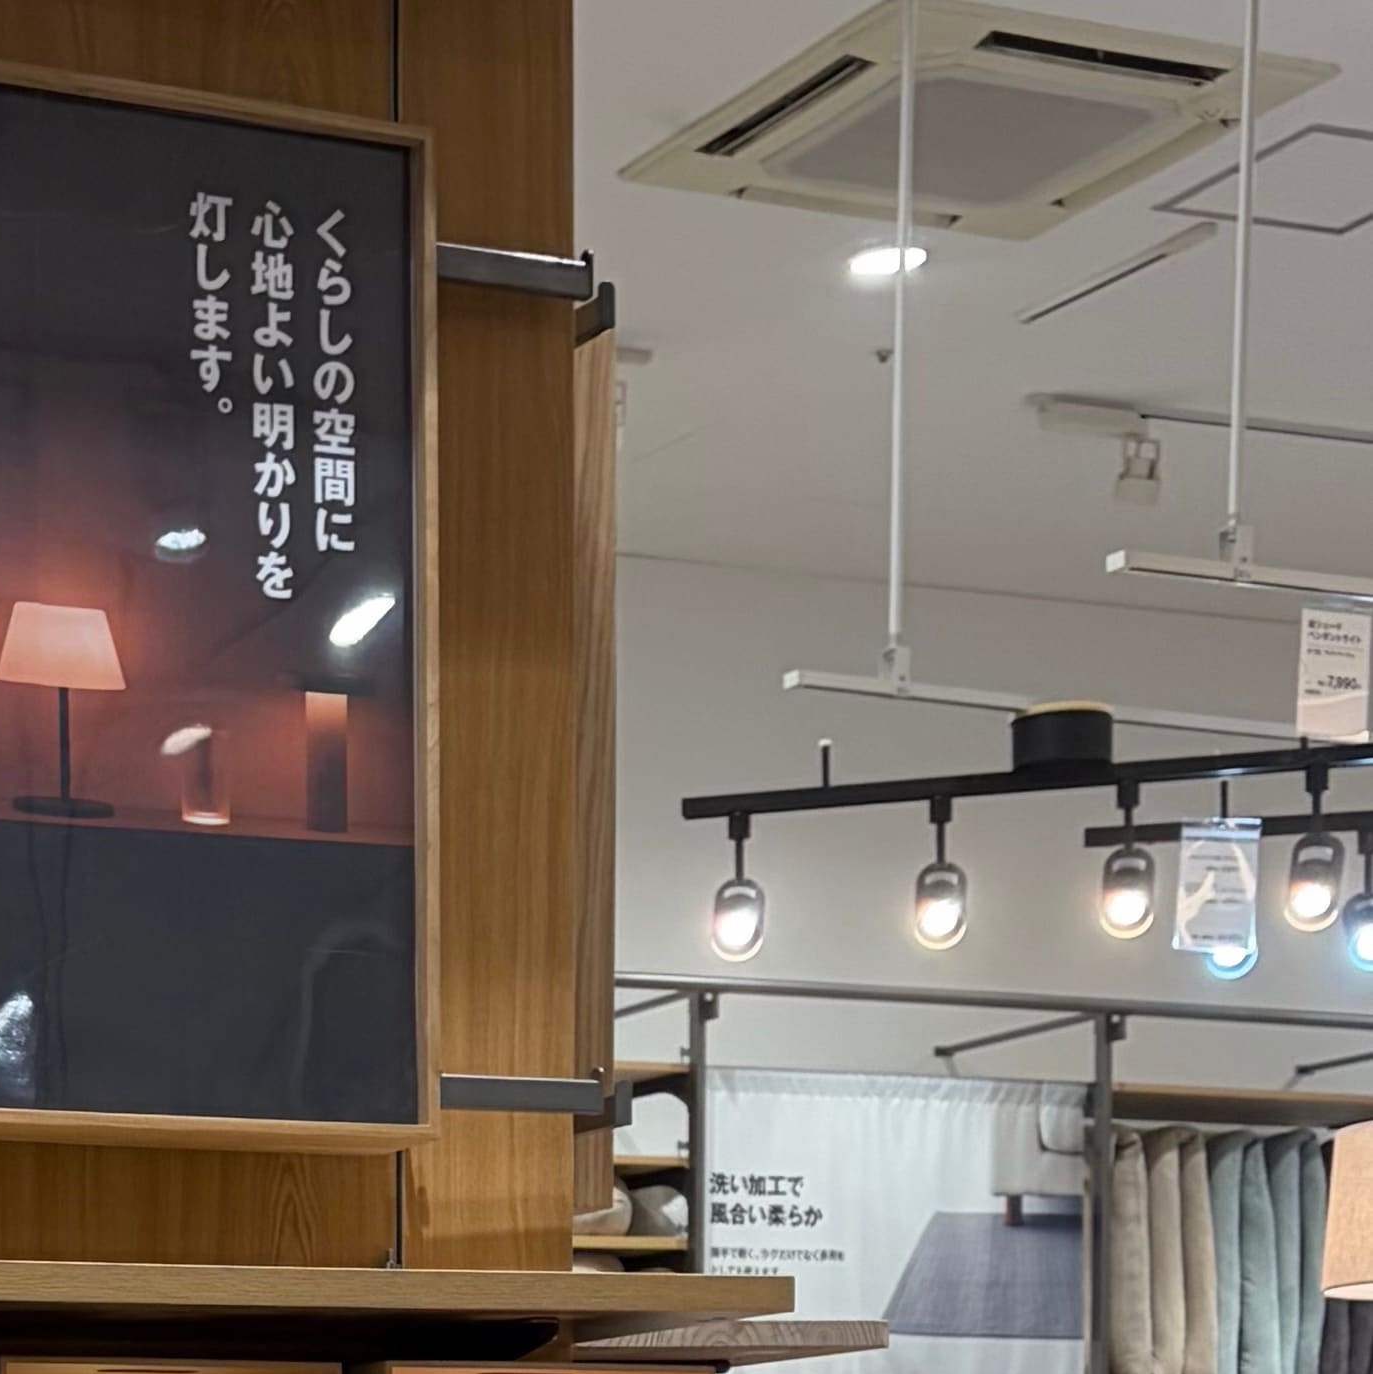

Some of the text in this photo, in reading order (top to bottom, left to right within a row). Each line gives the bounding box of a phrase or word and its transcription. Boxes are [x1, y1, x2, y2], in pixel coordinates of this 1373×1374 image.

[189, 191, 233, 414] 灯します。
[250, 200, 296, 600] 心地よい明かりを
[313, 208, 356, 552] くらしの空間に
[709, 1172, 804, 1197] 洗い加工で
[710, 1202, 824, 1228] 風合い柔らか
